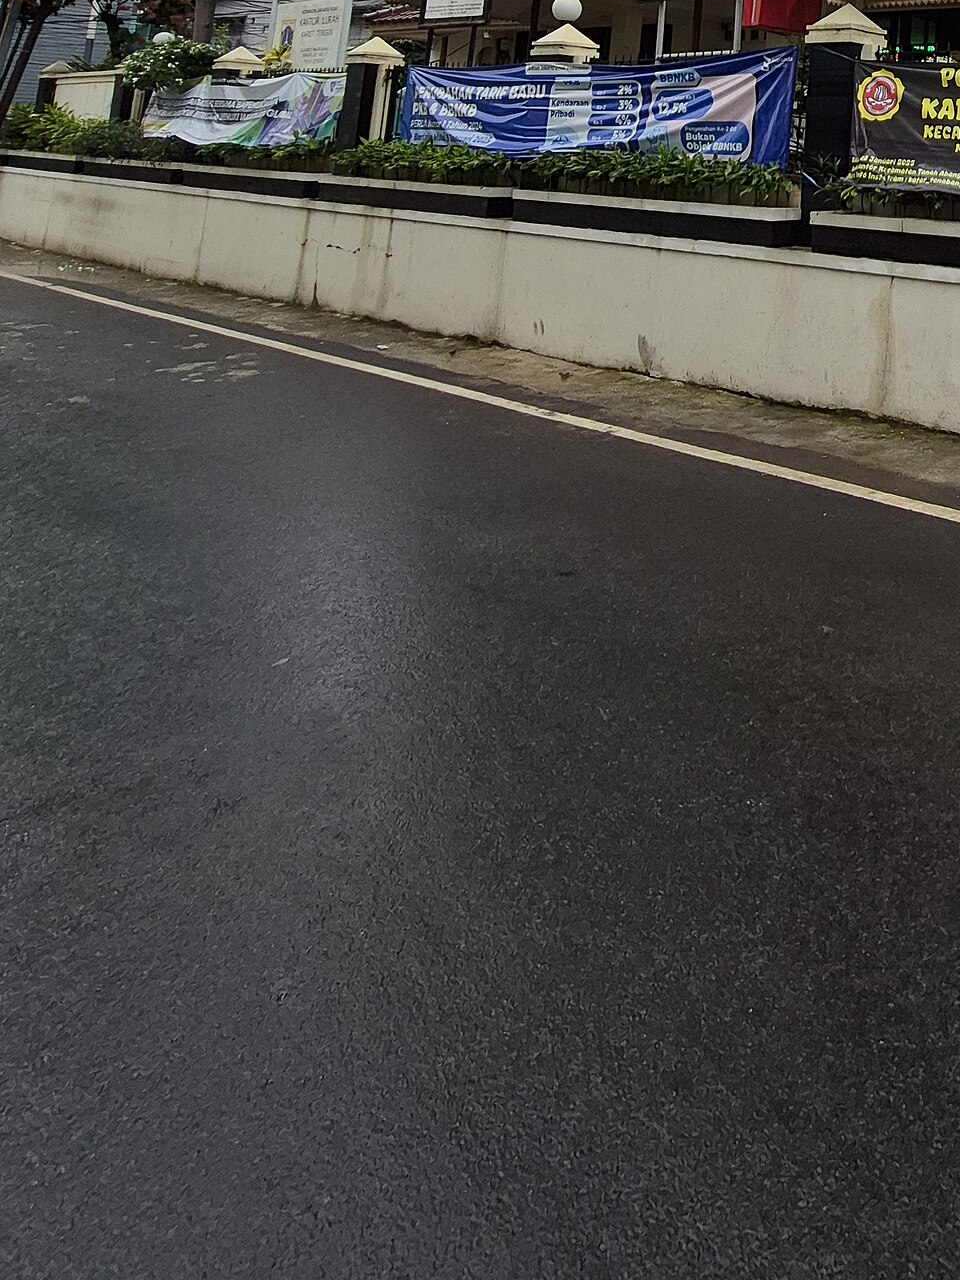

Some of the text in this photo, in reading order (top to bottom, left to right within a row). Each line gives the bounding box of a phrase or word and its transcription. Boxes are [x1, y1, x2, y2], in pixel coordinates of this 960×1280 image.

[660, 73, 695, 83] BBNKB
[475, 85, 509, 100] TARIF
[508, 84, 547, 99] BARU
[617, 84, 633, 95] 2%
[551, 99, 589, 107] Kendaraan
[617, 99, 634, 110] 3%
[550, 110, 575, 118] Pribadi
[657, 102, 689, 116] 12,5%
[446, 120, 468, 130] Tahun
[611, 130, 626, 141] 5%
[685, 132, 716, 141] Bukan
[712, 142, 743, 152] BBNKB
[869, 155, 897, 165] Januari
[897, 158, 915, 167] 2025
[917, 168, 938, 176] Tanah
